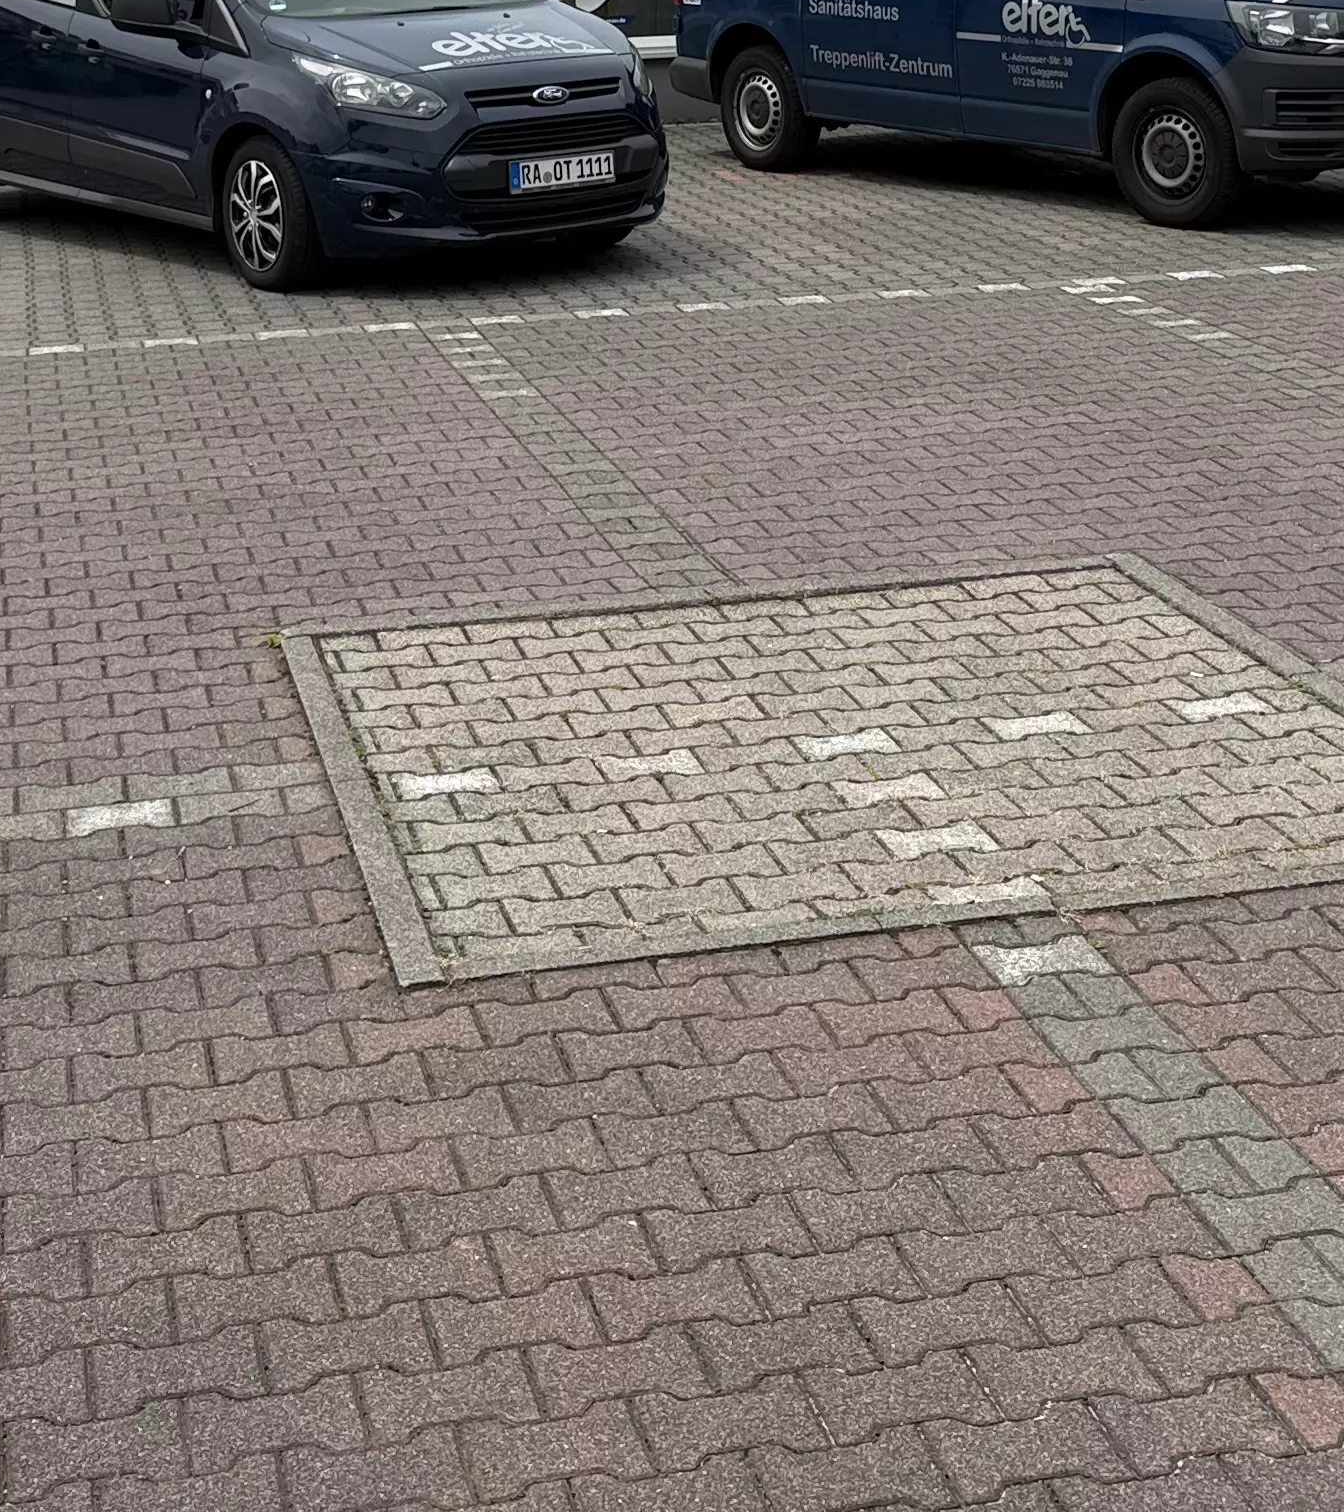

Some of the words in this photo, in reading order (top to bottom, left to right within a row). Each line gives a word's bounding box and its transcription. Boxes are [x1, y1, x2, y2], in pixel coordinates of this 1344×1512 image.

[432, 32, 552, 56] elter
[810, 44, 953, 78] Treppenlift-Zentrum
[522, 163, 542, 185] RA
[553, 160, 572, 181] OT
[576, 156, 612, 179] 1111
